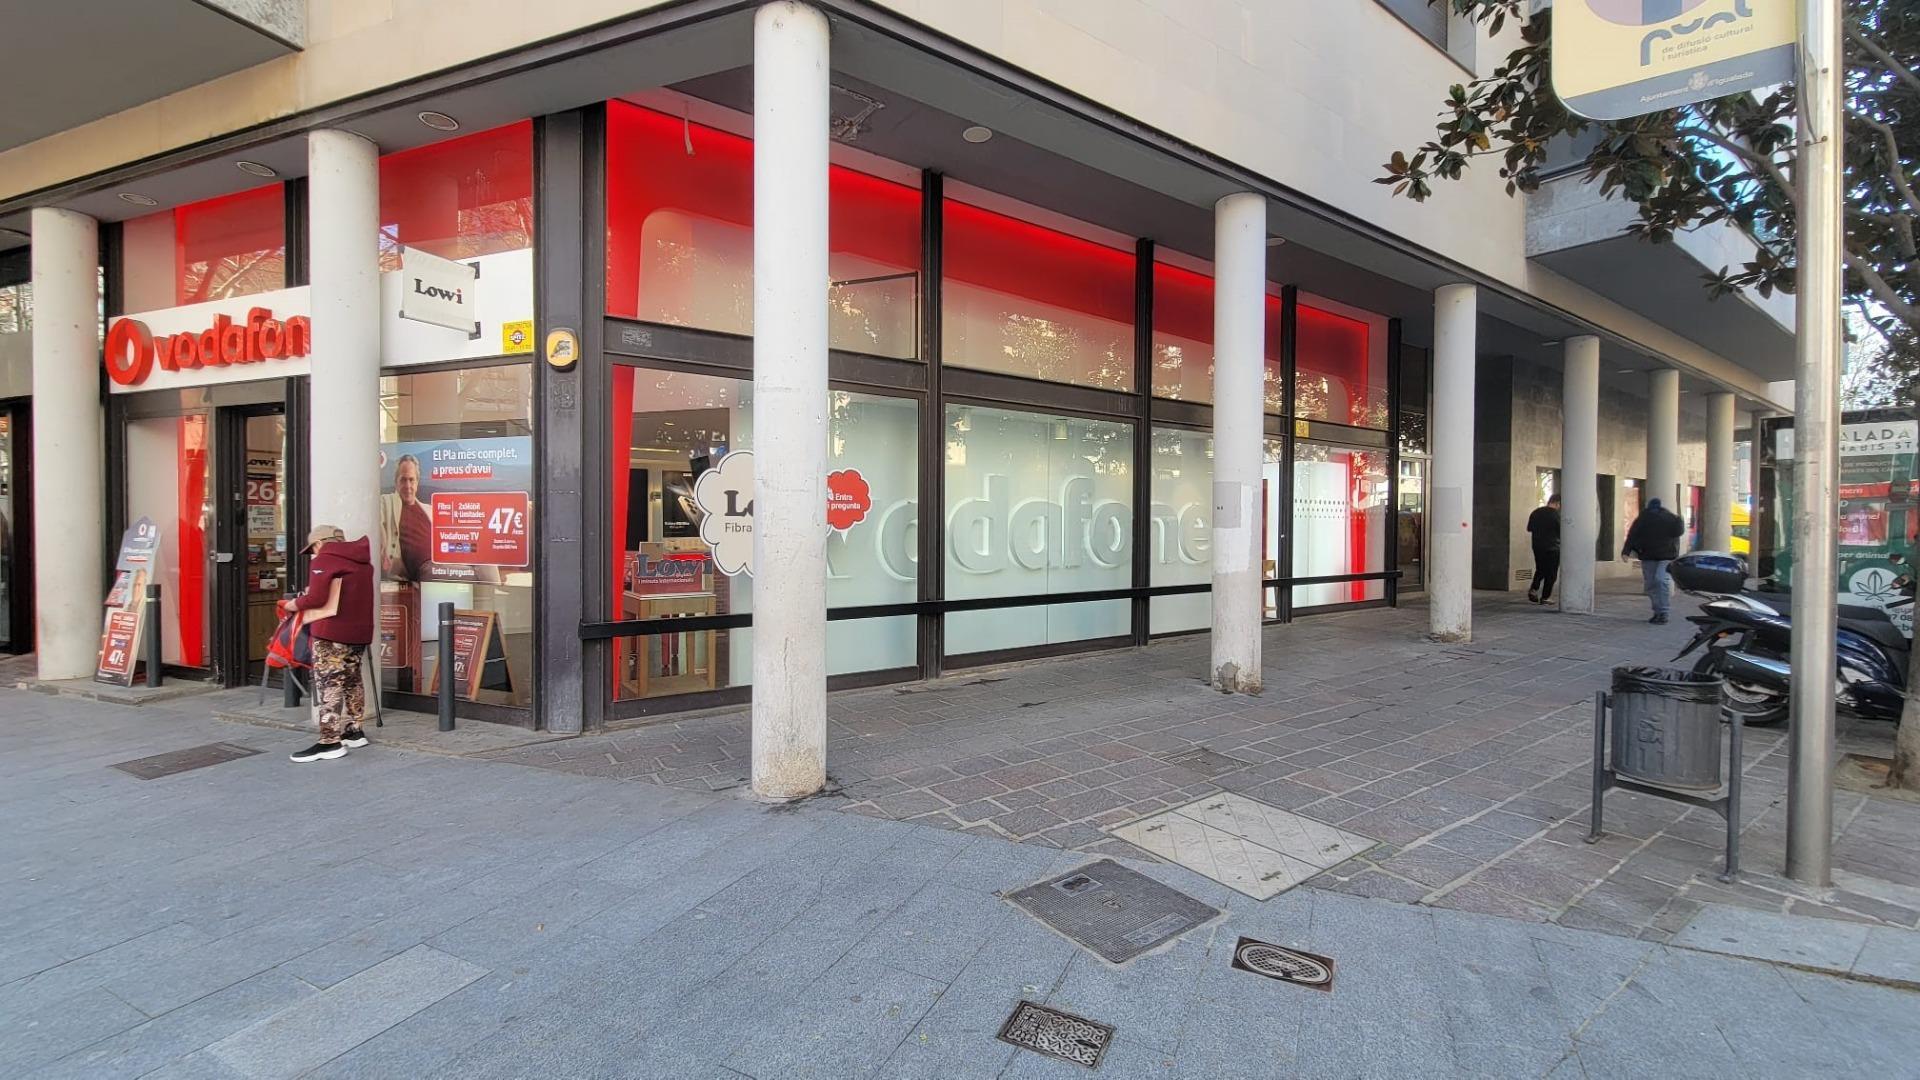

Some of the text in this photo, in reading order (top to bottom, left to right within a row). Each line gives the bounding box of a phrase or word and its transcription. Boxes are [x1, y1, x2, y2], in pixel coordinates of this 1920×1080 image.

[1662, 46, 1674, 54] de
[1714, 25, 1753, 40] cultural
[1640, 86, 1689, 103] Ajuntament
[413, 278, 463, 305] Lowi
[153, 307, 311, 372] vodafon
[1840, 428, 1911, 442] ALADA
[1895, 441, 1912, 450] ST
[433, 447, 518, 461] El Pla més complet,
[433, 463, 492, 478] a preus d'avui
[831, 502, 861, 511] pregunta
[724, 522, 753, 533] Fibra
[440, 531, 479, 541] Vodafone TV
